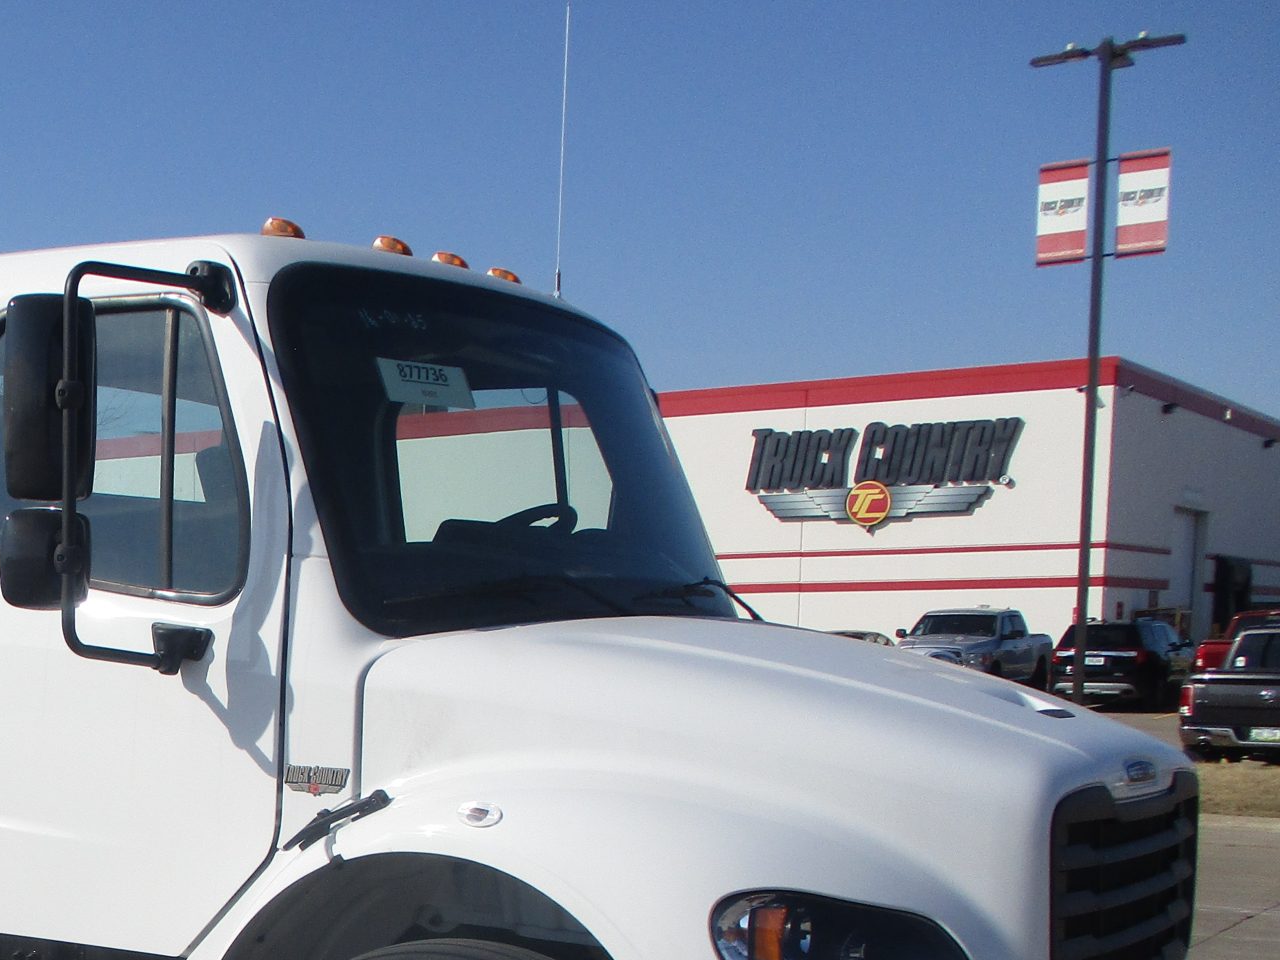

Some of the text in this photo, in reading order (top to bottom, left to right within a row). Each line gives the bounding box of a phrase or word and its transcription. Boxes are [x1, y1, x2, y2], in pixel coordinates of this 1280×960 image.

[396, 363, 448, 382] 877736
[745, 416, 1026, 494] TRUCK COUNTRY
[311, 766, 350, 788] COUNTRY
